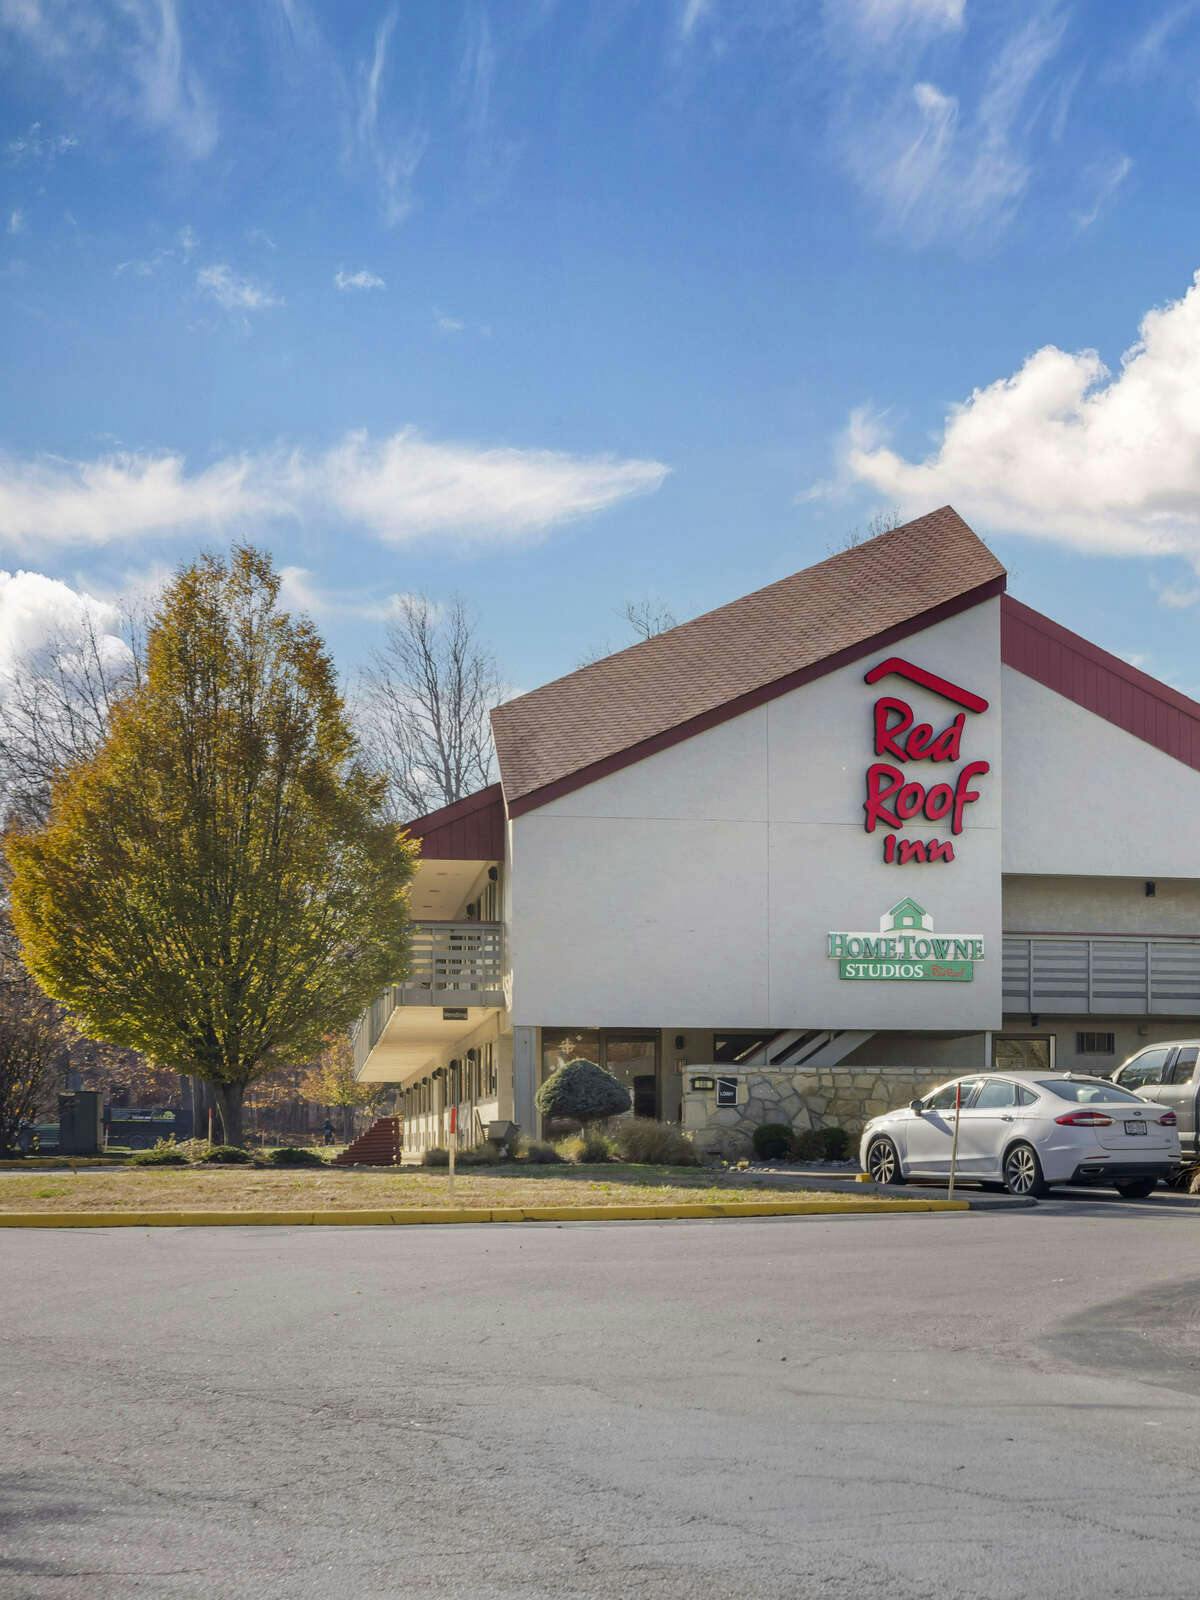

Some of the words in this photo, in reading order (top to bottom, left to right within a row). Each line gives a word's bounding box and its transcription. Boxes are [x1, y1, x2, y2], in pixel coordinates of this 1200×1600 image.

[874, 697, 966, 763] Red
[863, 761, 990, 835] Roof
[845, 963, 924, 978] STUDIOS
